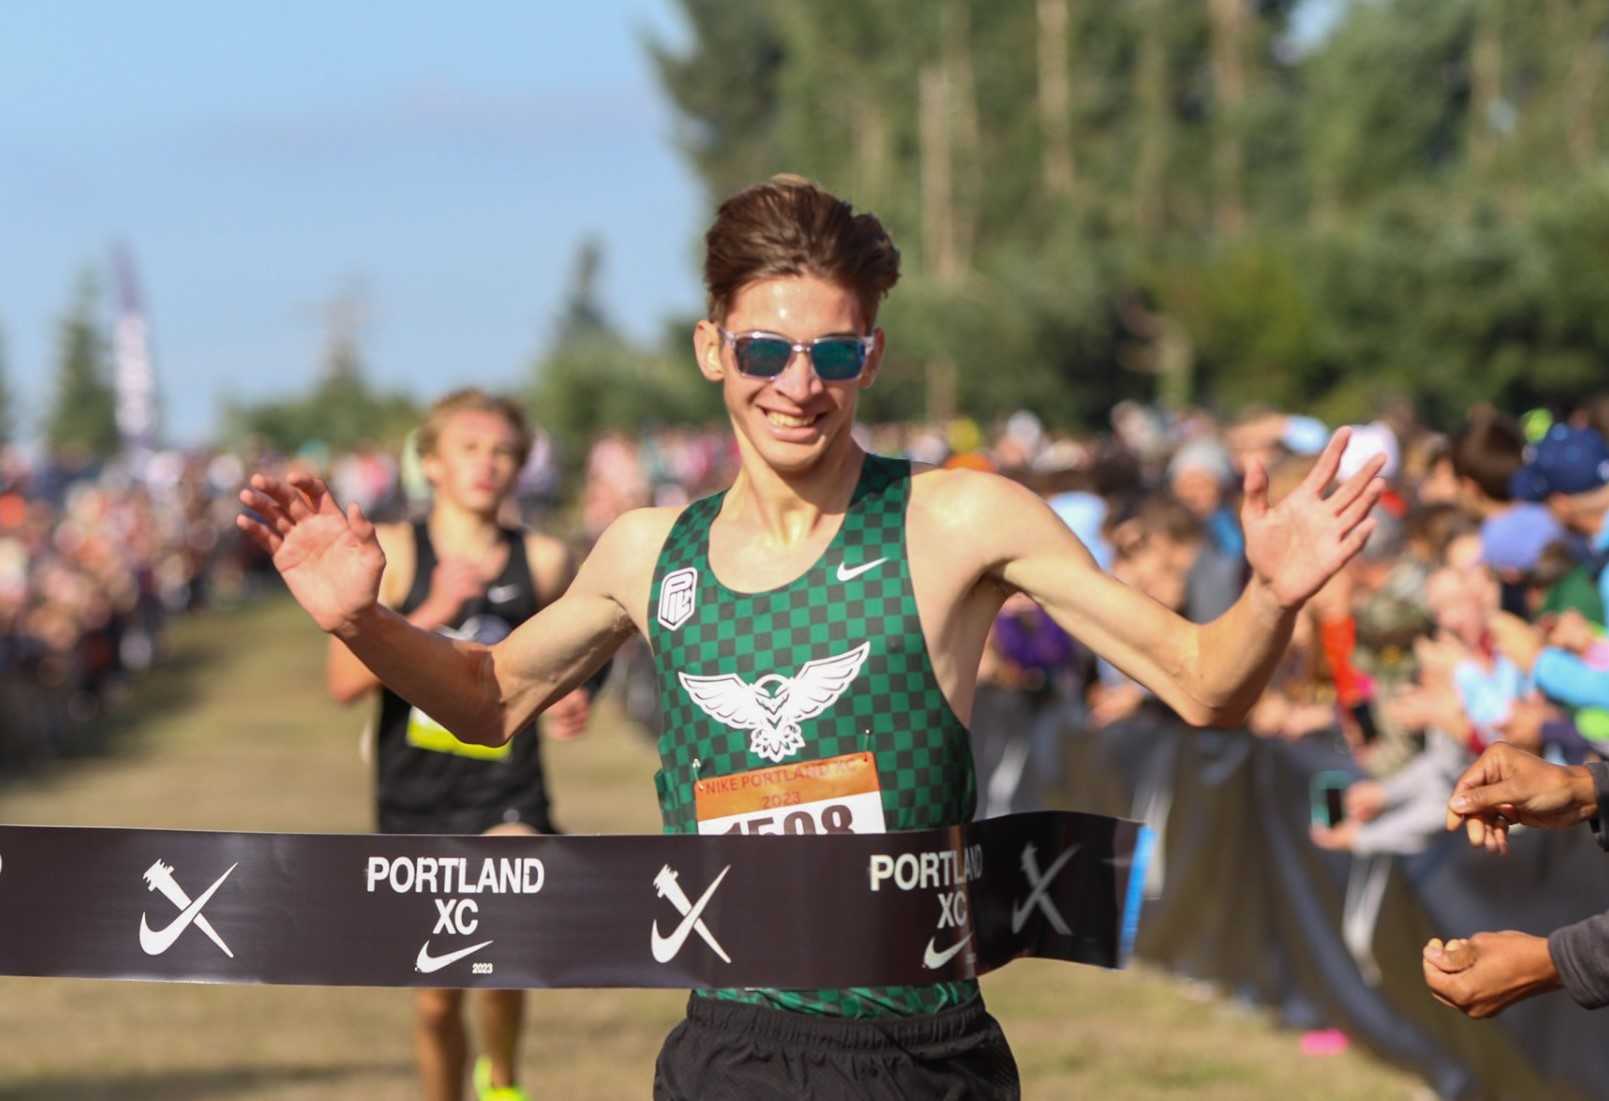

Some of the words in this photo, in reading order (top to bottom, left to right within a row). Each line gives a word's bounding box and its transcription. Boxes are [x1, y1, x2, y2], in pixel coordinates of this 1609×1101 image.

[705, 777, 738, 794] NIKE
[760, 791, 801, 810] 2023
[367, 856, 545, 894] PORTLAND
[432, 898, 479, 936] XC
[937, 890, 968, 929] XC
[472, 962, 493, 975] 2023
